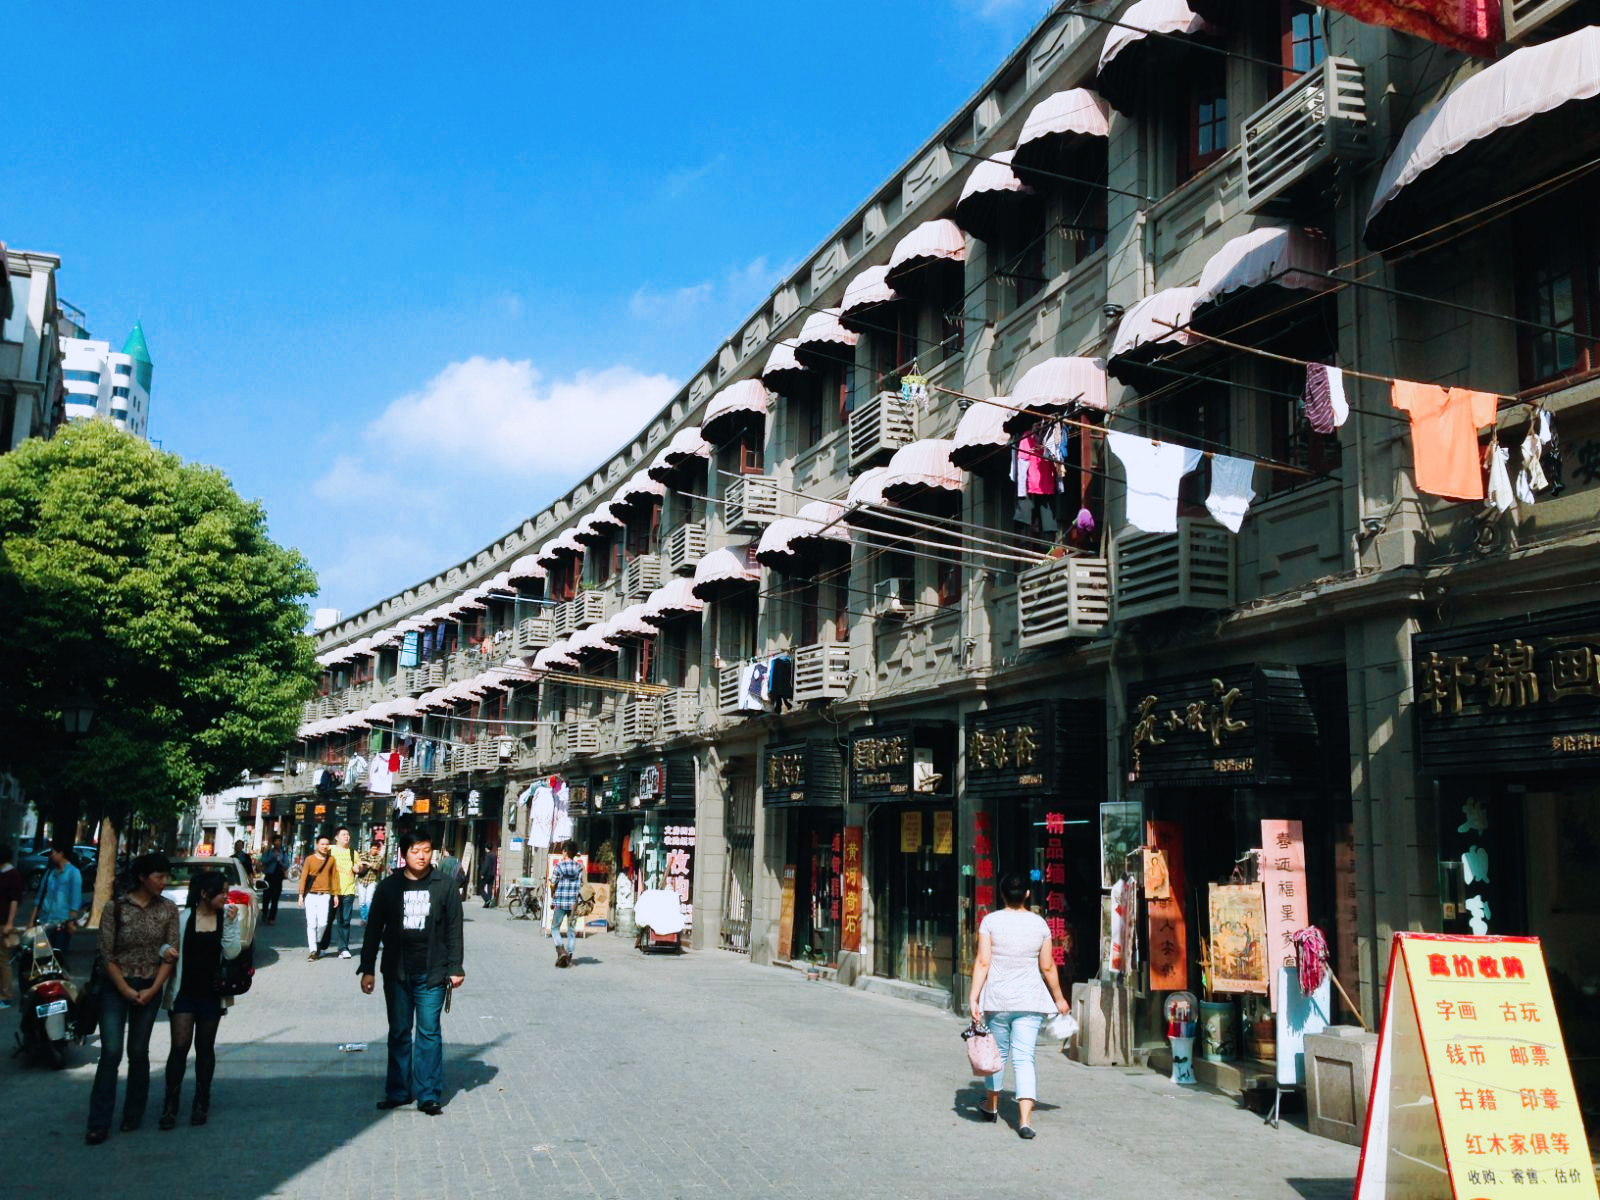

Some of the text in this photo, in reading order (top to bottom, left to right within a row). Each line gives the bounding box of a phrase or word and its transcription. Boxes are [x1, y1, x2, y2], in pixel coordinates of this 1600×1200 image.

[845, 842, 860, 933] 黄河奇石
[1427, 953, 1525, 979] 高价收购
[1437, 1000, 1541, 1022] 字画 古玩
[1446, 1043, 1550, 1067] 钱币 邮票
[1455, 1088, 1561, 1111] 古籍 印章
[1466, 1132, 1570, 1155] 红木家俱等
